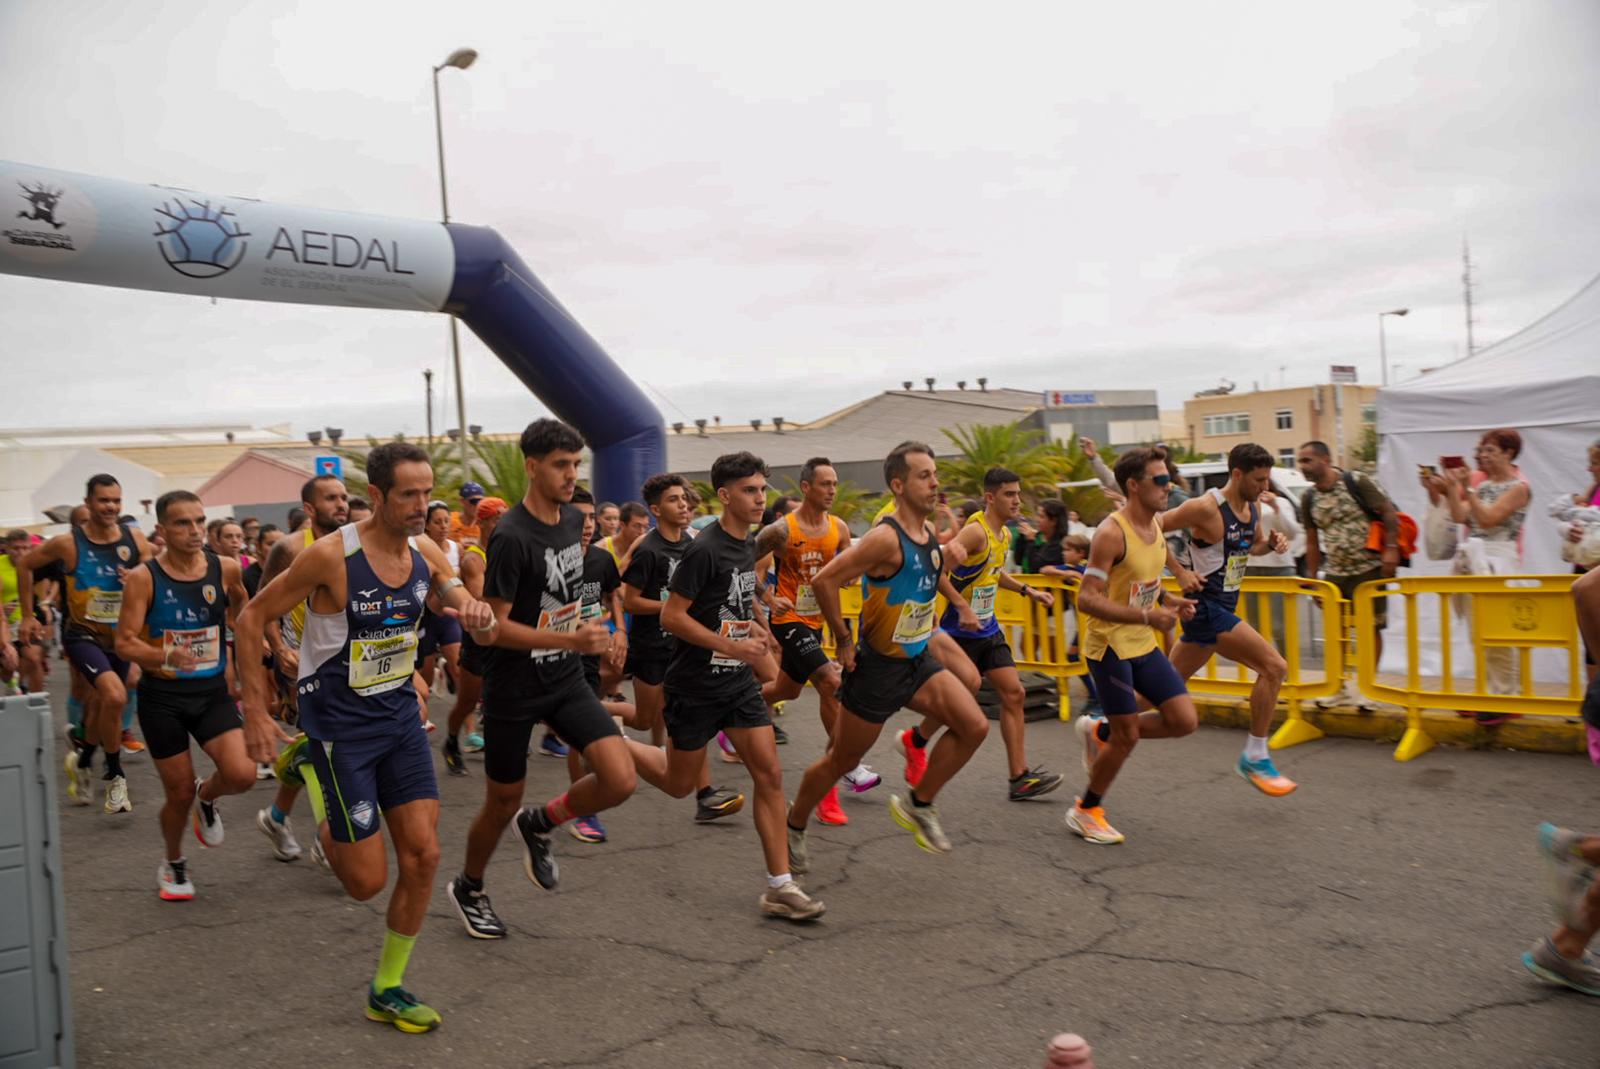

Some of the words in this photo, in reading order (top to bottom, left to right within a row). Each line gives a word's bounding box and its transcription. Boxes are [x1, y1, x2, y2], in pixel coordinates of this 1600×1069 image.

[265, 226, 416, 275] AEDAL
[360, 601, 382, 611] DXT
[377, 657, 391, 675] 16
